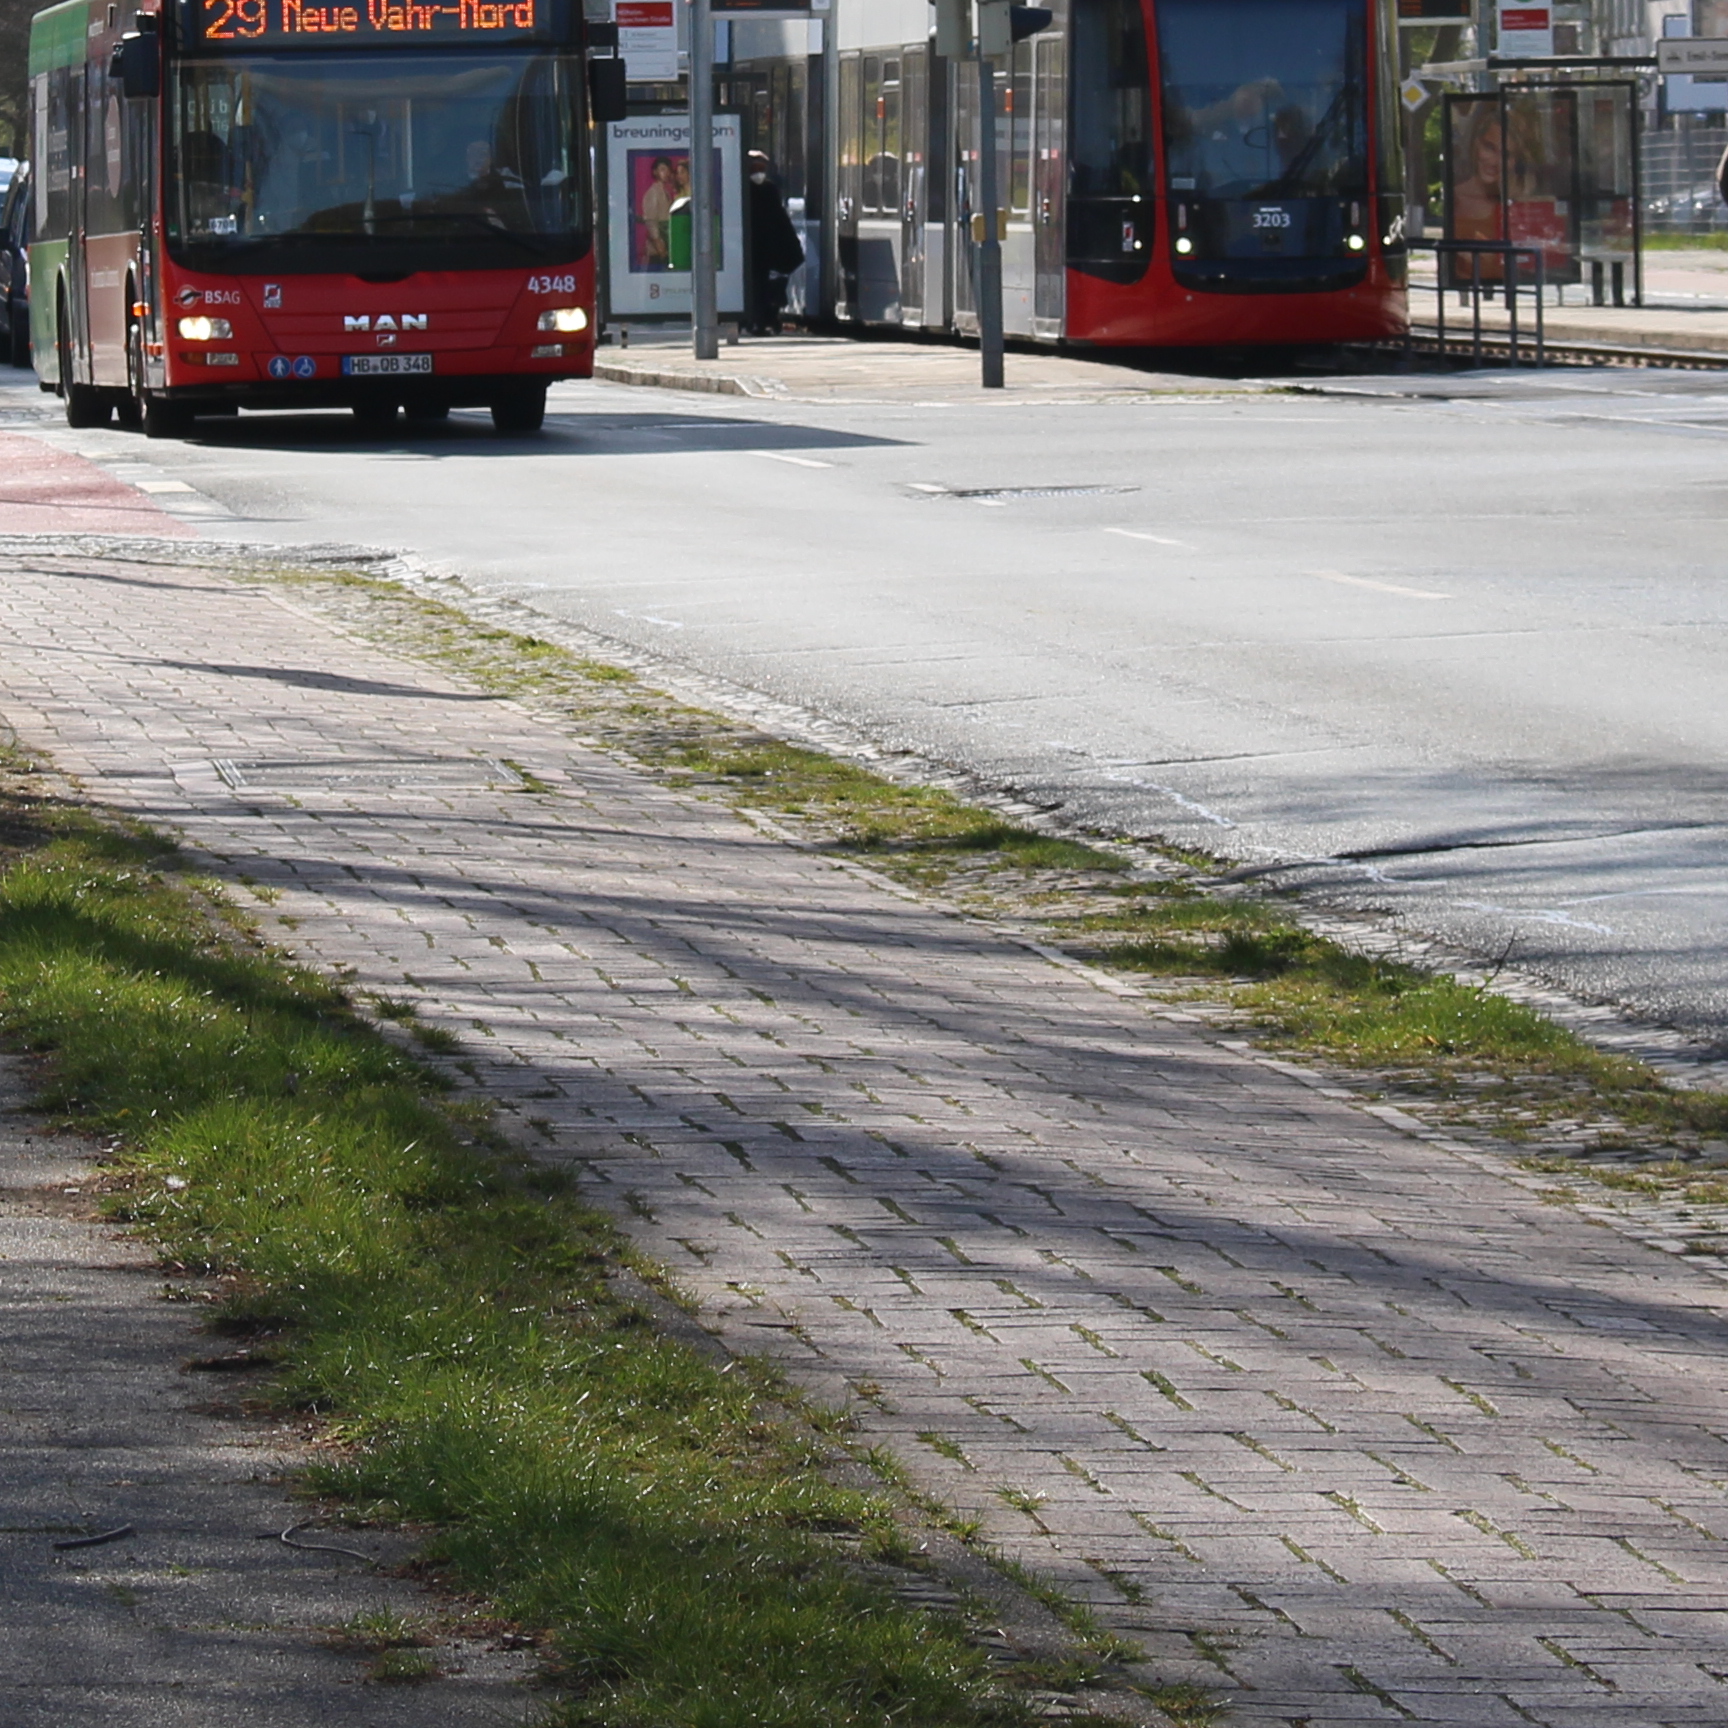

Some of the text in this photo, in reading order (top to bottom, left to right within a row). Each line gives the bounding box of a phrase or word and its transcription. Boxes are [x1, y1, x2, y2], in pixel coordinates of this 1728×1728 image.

[1252, 214, 1291, 227] 3203
[528, 275, 576, 293] 4348
[205, 291, 240, 304] BSAG
[344, 314, 428, 331] MAN
[351, 354, 430, 371] HB QB 348
